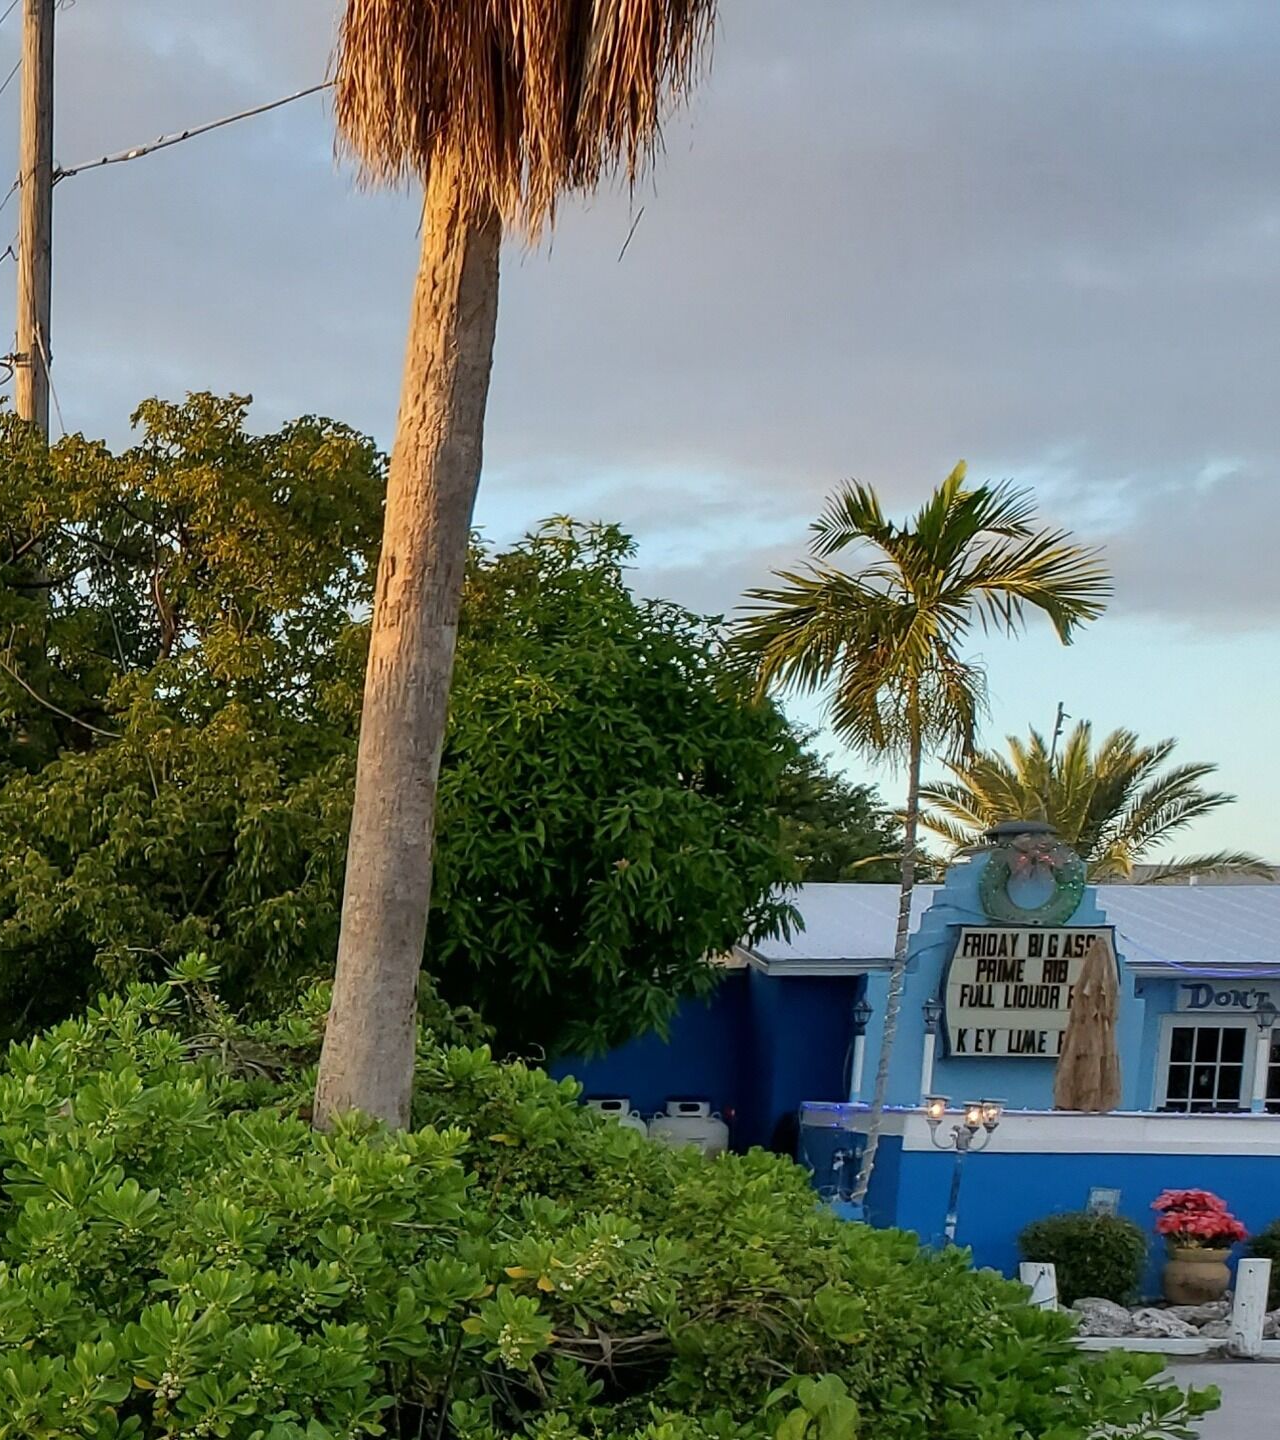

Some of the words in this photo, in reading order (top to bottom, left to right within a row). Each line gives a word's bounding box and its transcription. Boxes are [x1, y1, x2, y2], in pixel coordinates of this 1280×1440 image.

[962, 933, 1019, 957] FRIDAY
[976, 959, 1025, 983] PRIME
[1042, 960, 1069, 983] RIB
[959, 984, 995, 1008] FULL
[1007, 1029, 1048, 1053] LIME
